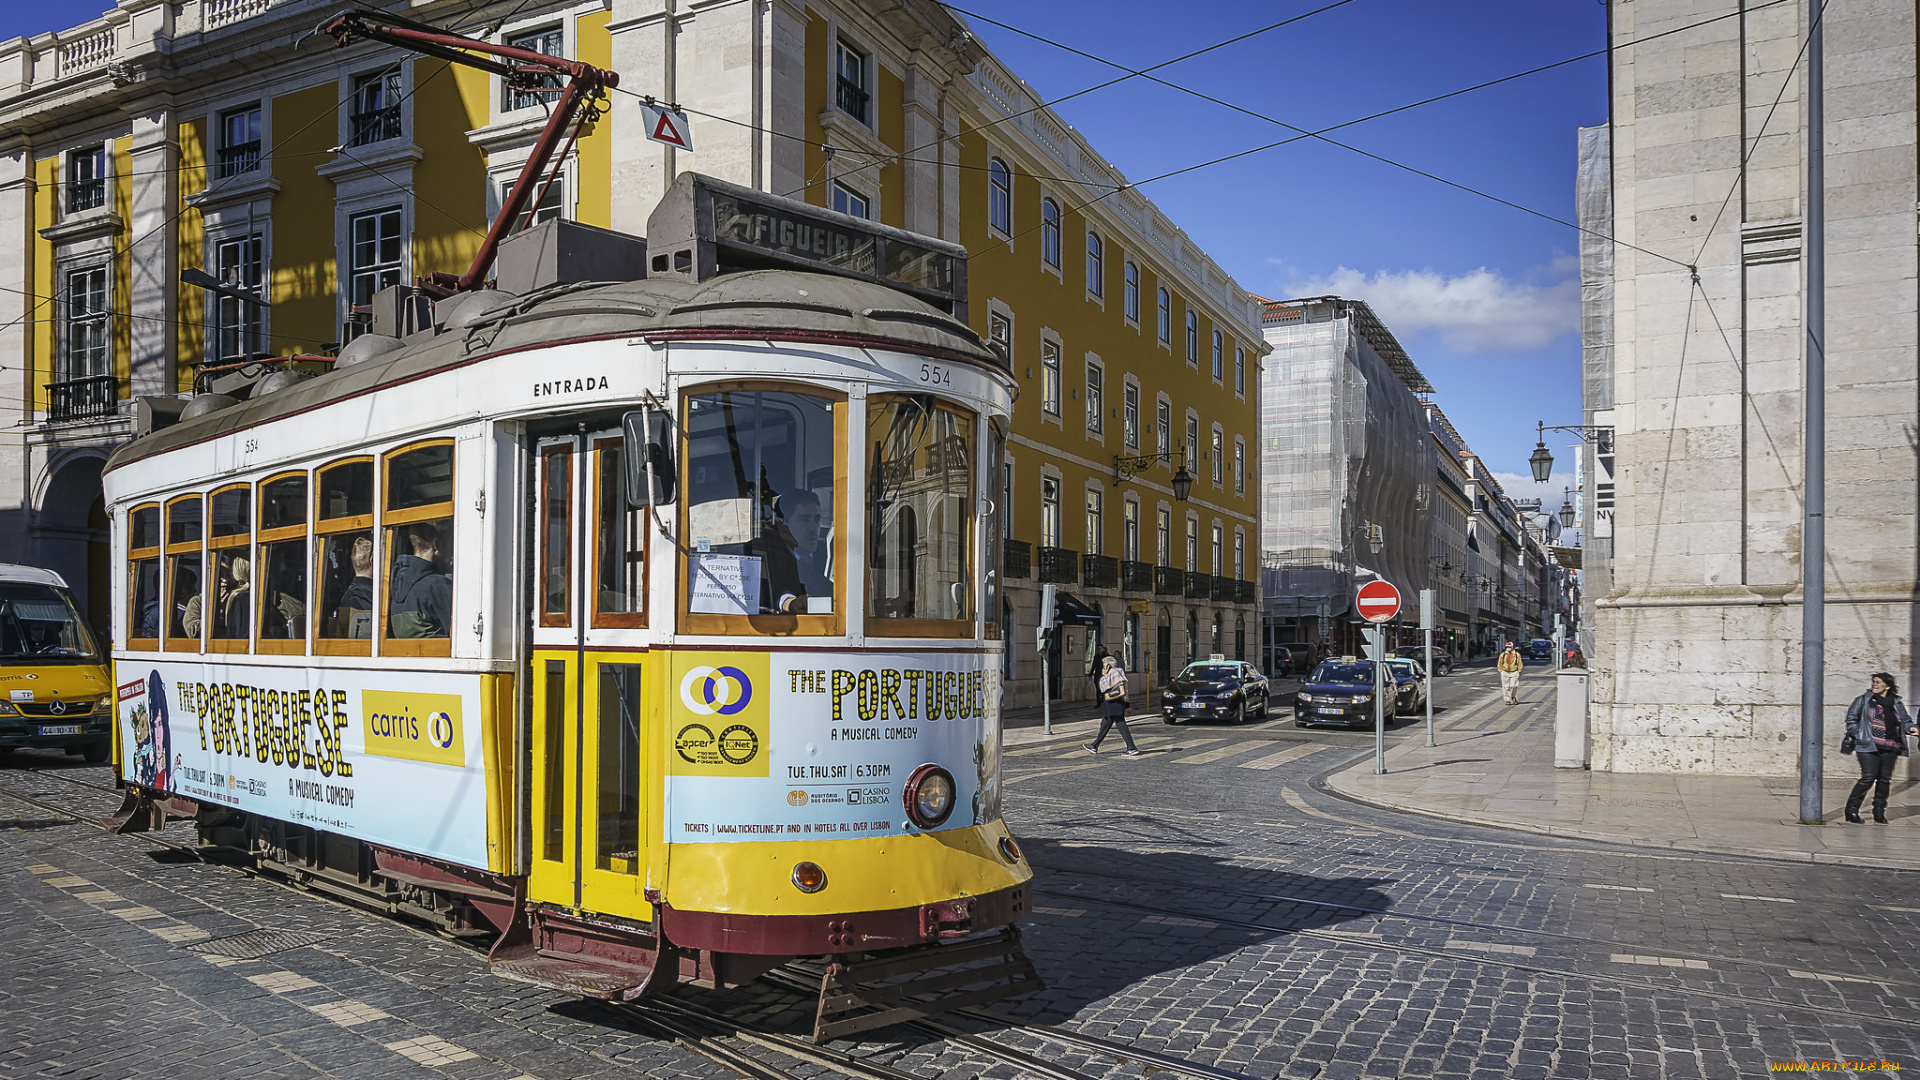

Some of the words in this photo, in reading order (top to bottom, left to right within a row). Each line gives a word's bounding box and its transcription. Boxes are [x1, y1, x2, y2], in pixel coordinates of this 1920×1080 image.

[920, 363, 950, 387] 554
[534, 375, 609, 397] ENTRADA
[245, 438, 259, 454] 554
[788, 670, 826, 693] THE
[832, 669, 997, 721] PORTUGUESE
[176, 681, 196, 713] THE
[196, 682, 353, 778] PORTUGUESE
[371, 706, 419, 740] carris
[831, 729, 838, 741] A
[842, 728, 881, 741] MUSICAL
[885, 727, 918, 740] COMEDY
[682, 740, 709, 750] apcer
[787, 765, 848, 779] TUE.THU.SAT
[856, 764, 891, 778] 6.30PM
[289, 778, 294, 796] A
[296, 780, 324, 803] MUSICAL
[326, 786, 355, 809] COMEDY
[862, 786, 891, 796] CASINO
[862, 796, 890, 805] LISBOA
[684, 823, 709, 833] TICKETS
[717, 823, 785, 834] WWW.TICKETLINE.PT
[787, 824, 801, 833] AND
[804, 824, 812, 833] IN
[814, 823, 837, 833] HOTELS
[839, 823, 850, 832] ALL
[853, 822, 868, 831] OVER
[870, 821, 891, 830] LISBON
